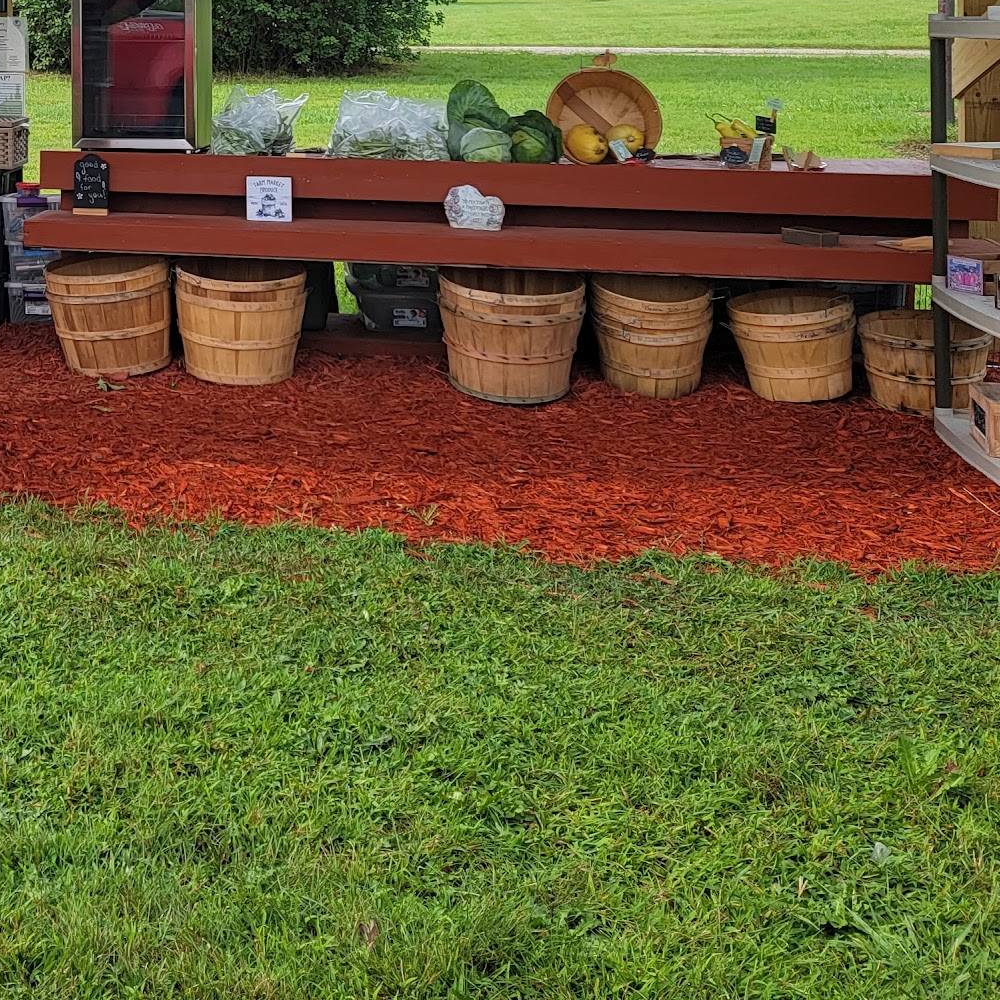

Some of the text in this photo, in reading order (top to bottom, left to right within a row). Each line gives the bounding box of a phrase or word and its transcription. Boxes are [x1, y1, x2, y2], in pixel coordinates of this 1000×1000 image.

[79, 161, 99, 175] good
[82, 172, 102, 183] food
[80, 183, 93, 191] for
[253, 179, 285, 189] FARM MARKET
[87, 189, 107, 204] you!
